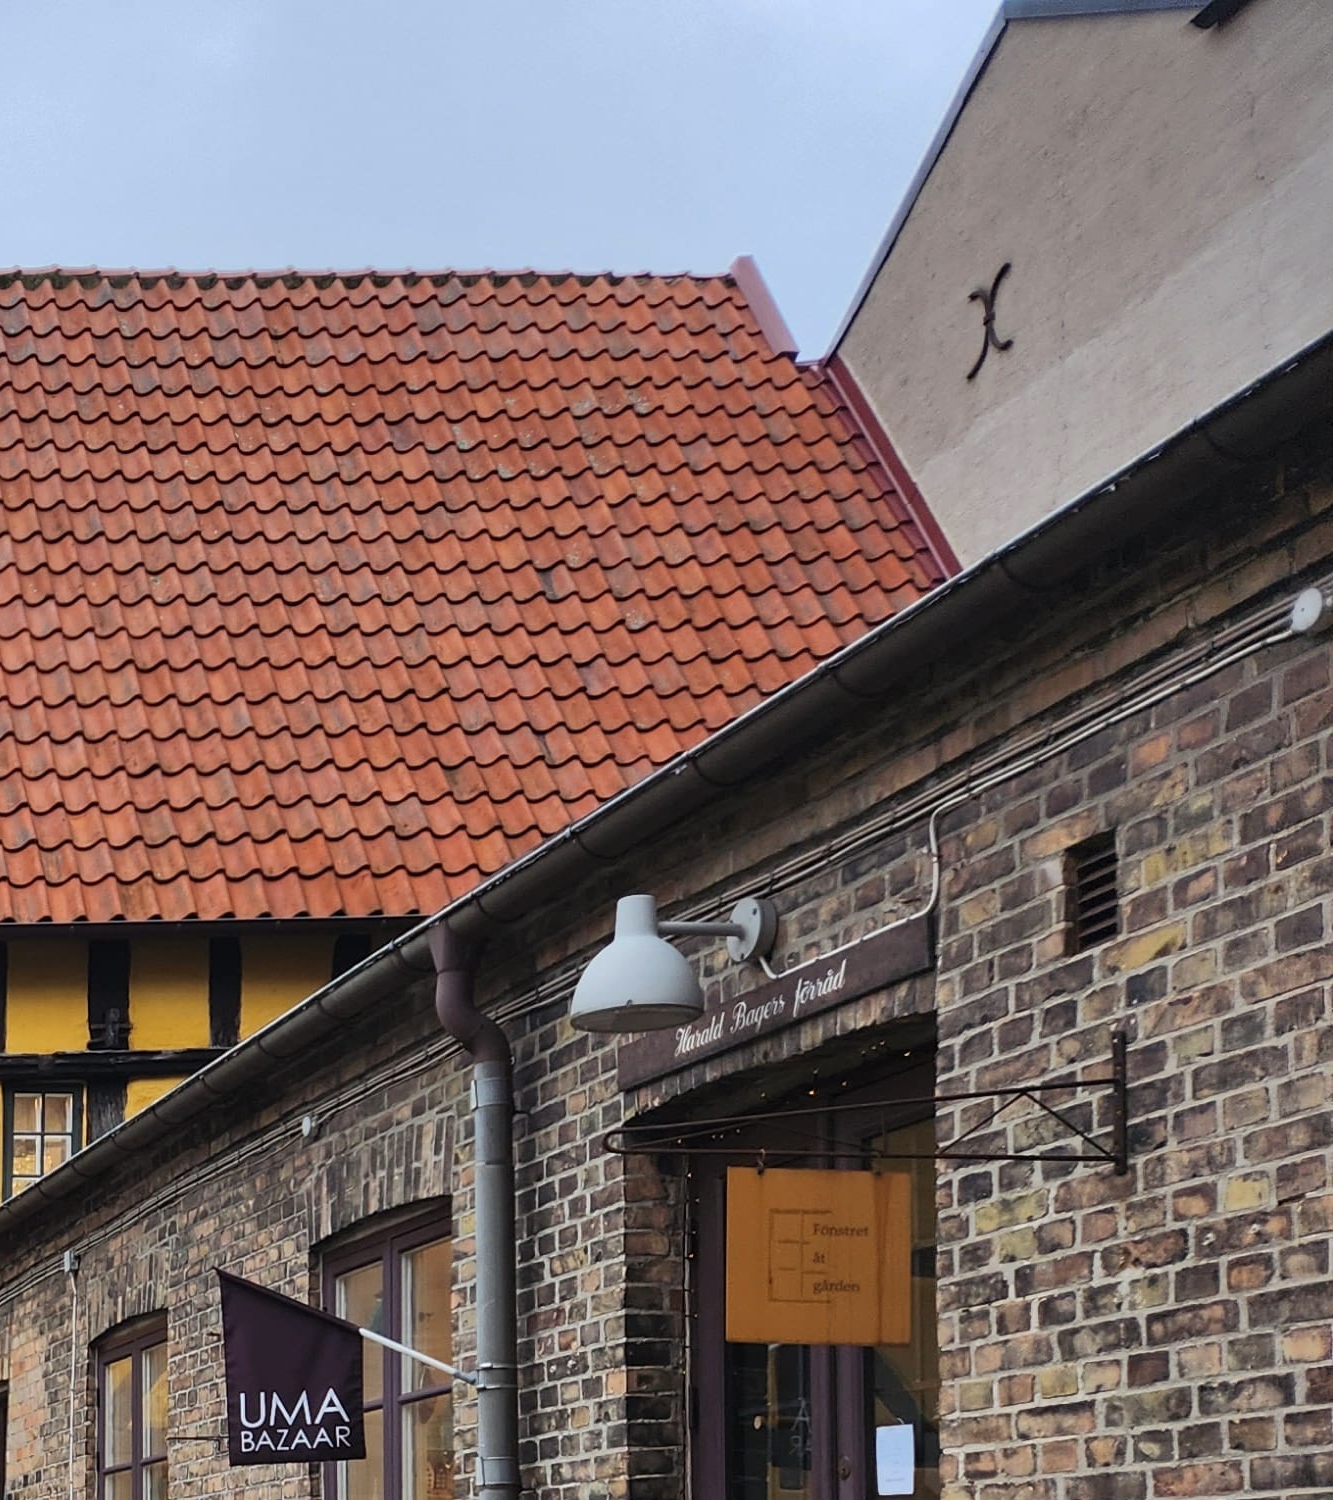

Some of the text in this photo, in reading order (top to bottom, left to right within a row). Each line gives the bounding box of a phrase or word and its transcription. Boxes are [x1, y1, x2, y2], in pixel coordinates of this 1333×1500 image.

[674, 958, 847, 1057] Harald Bagers förråd
[239, 1387, 350, 1428] UMA
[240, 1425, 351, 1452] BAZAAR
